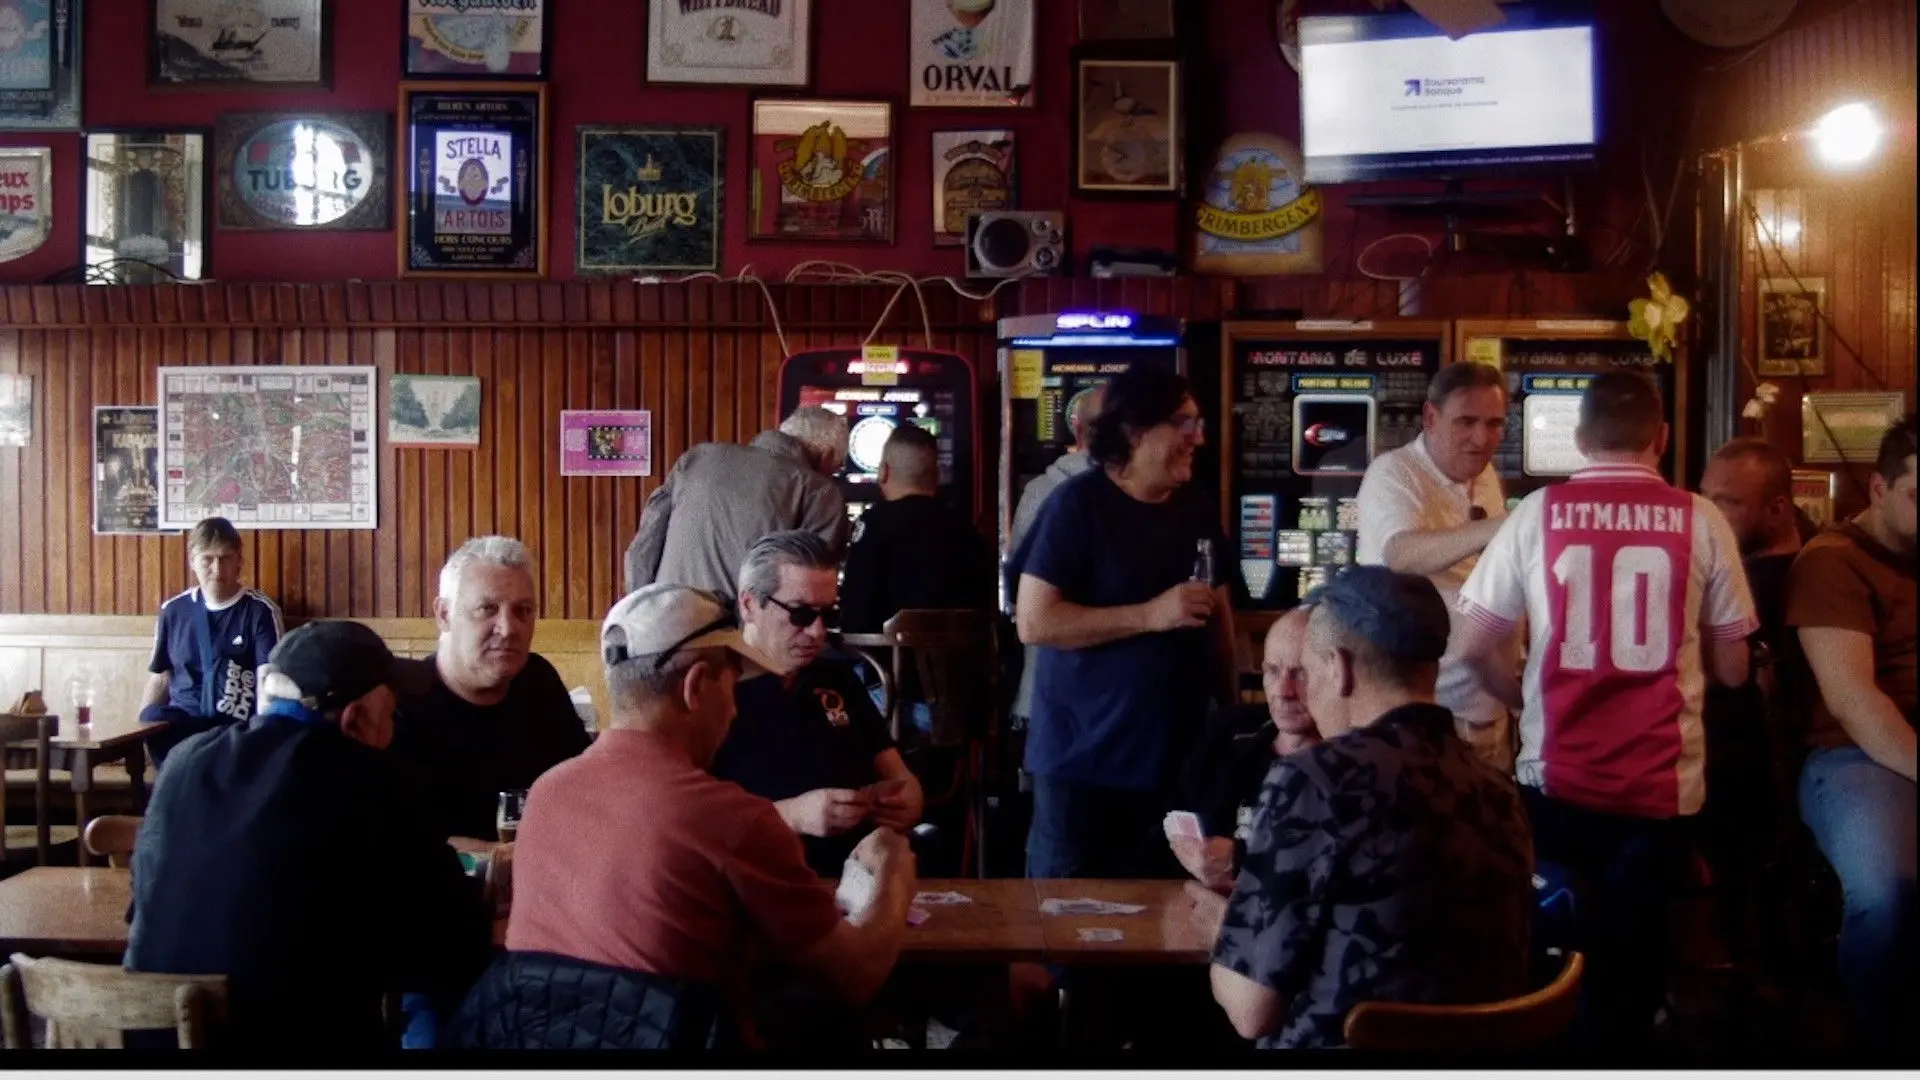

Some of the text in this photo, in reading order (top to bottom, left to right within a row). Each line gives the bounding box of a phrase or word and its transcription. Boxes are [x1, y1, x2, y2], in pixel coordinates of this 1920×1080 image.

[923, 64, 1013, 92] ORVAL
[446, 137, 501, 160] STELLA
[443, 209, 505, 229] ARTOIS
[602, 184, 697, 225] Loburg
[1249, 351, 1335, 366] MONTANA
[1375, 351, 1423, 366] LUXE
[1551, 502, 1684, 533] LITMANEN
[1553, 544, 1672, 672] 10
[215, 659, 242, 714] Super
